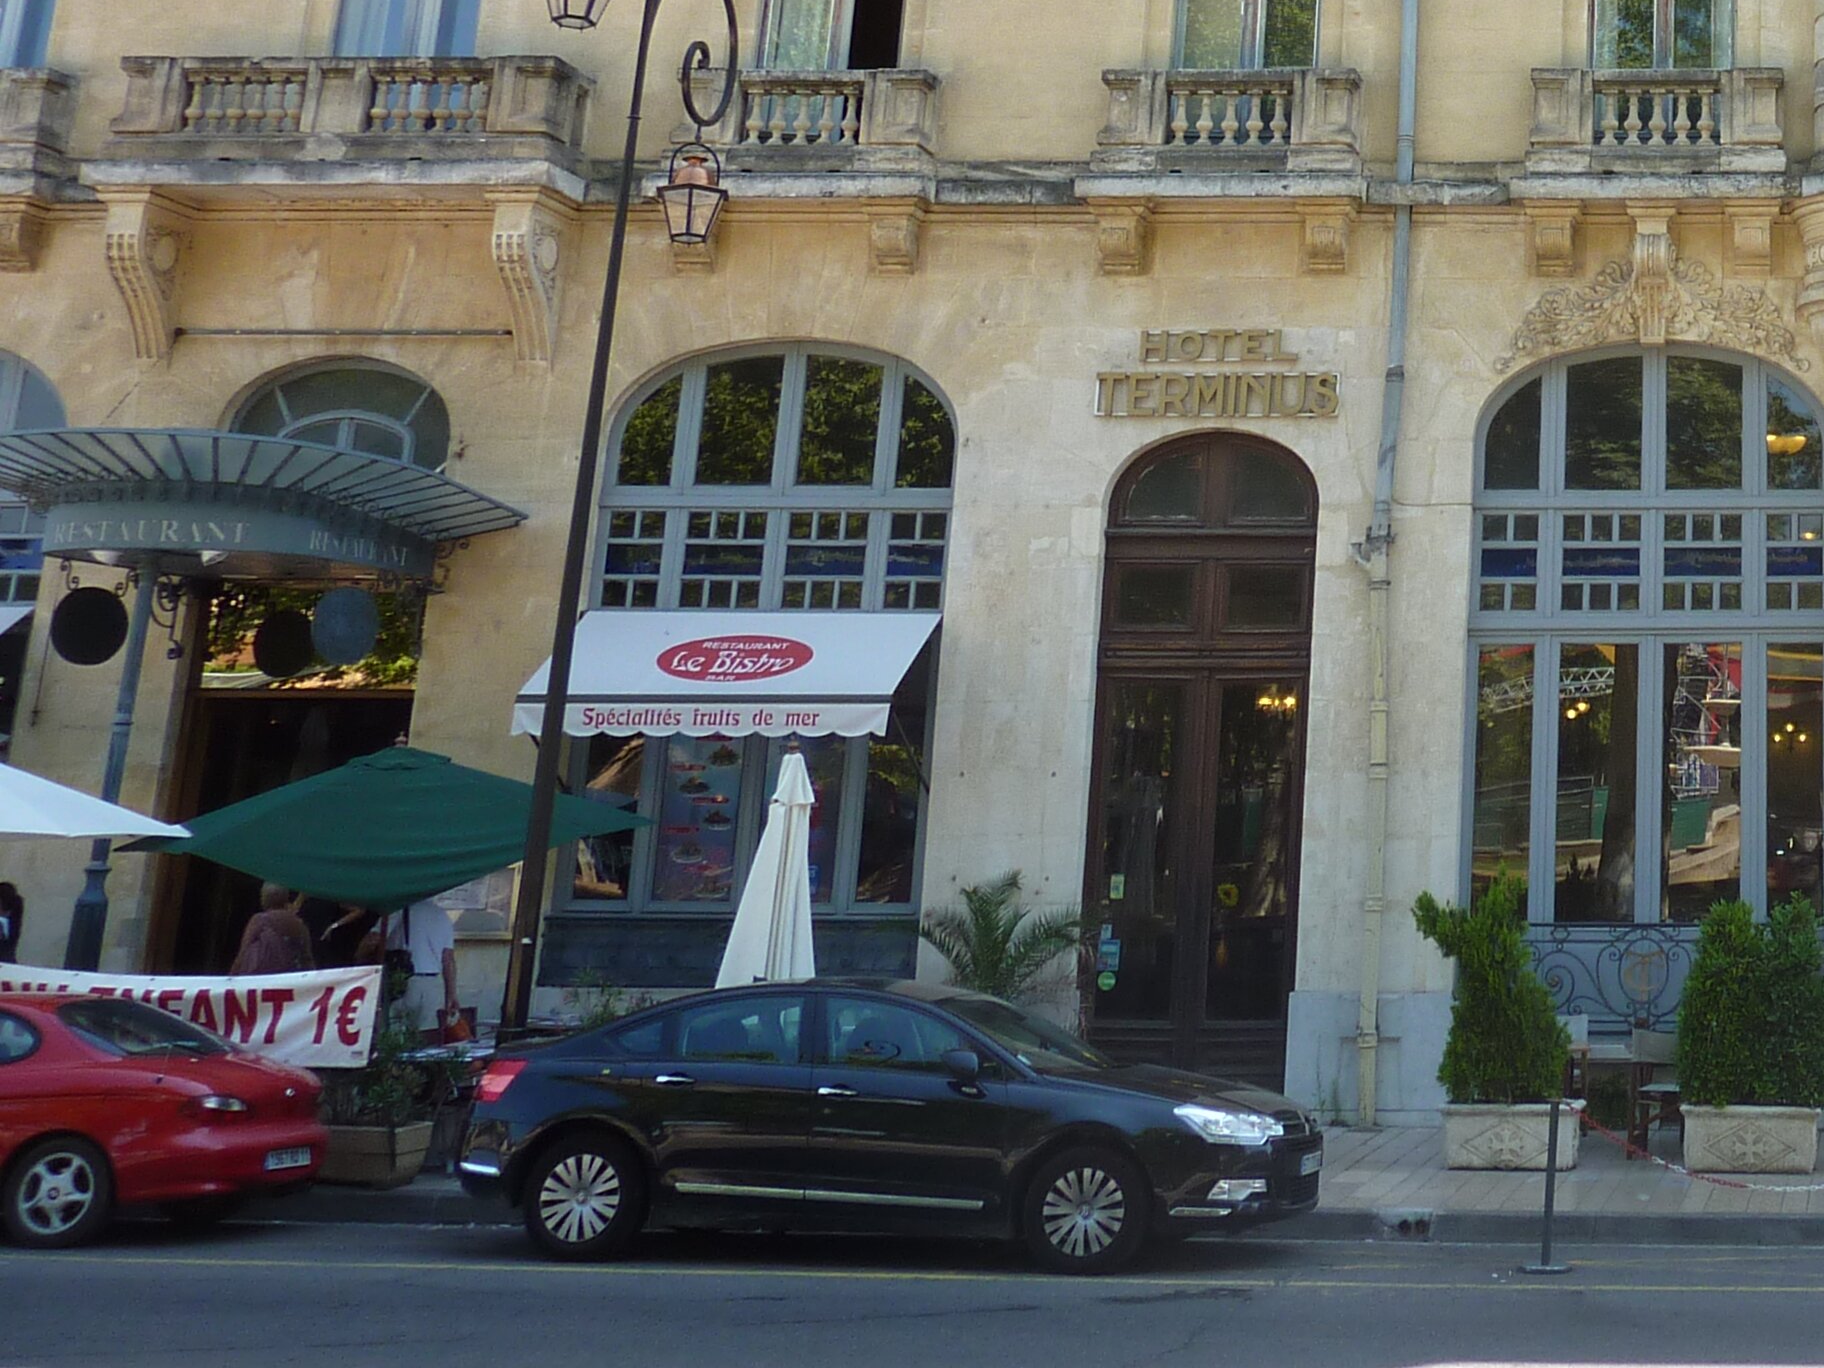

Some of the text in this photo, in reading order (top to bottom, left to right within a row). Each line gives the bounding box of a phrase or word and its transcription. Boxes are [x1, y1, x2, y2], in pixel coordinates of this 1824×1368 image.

[1139, 329, 1299, 362] HOTEL
[1096, 370, 1340, 418] TERMINUS
[53, 520, 250, 545] RESTAURANT
[702, 641, 790, 651] RESTAURANT
[670, 650, 795, 674] Le Bistro
[752, 709, 774, 727] de
[785, 712, 820, 727] mer
[309, 985, 367, 1047] 1€
